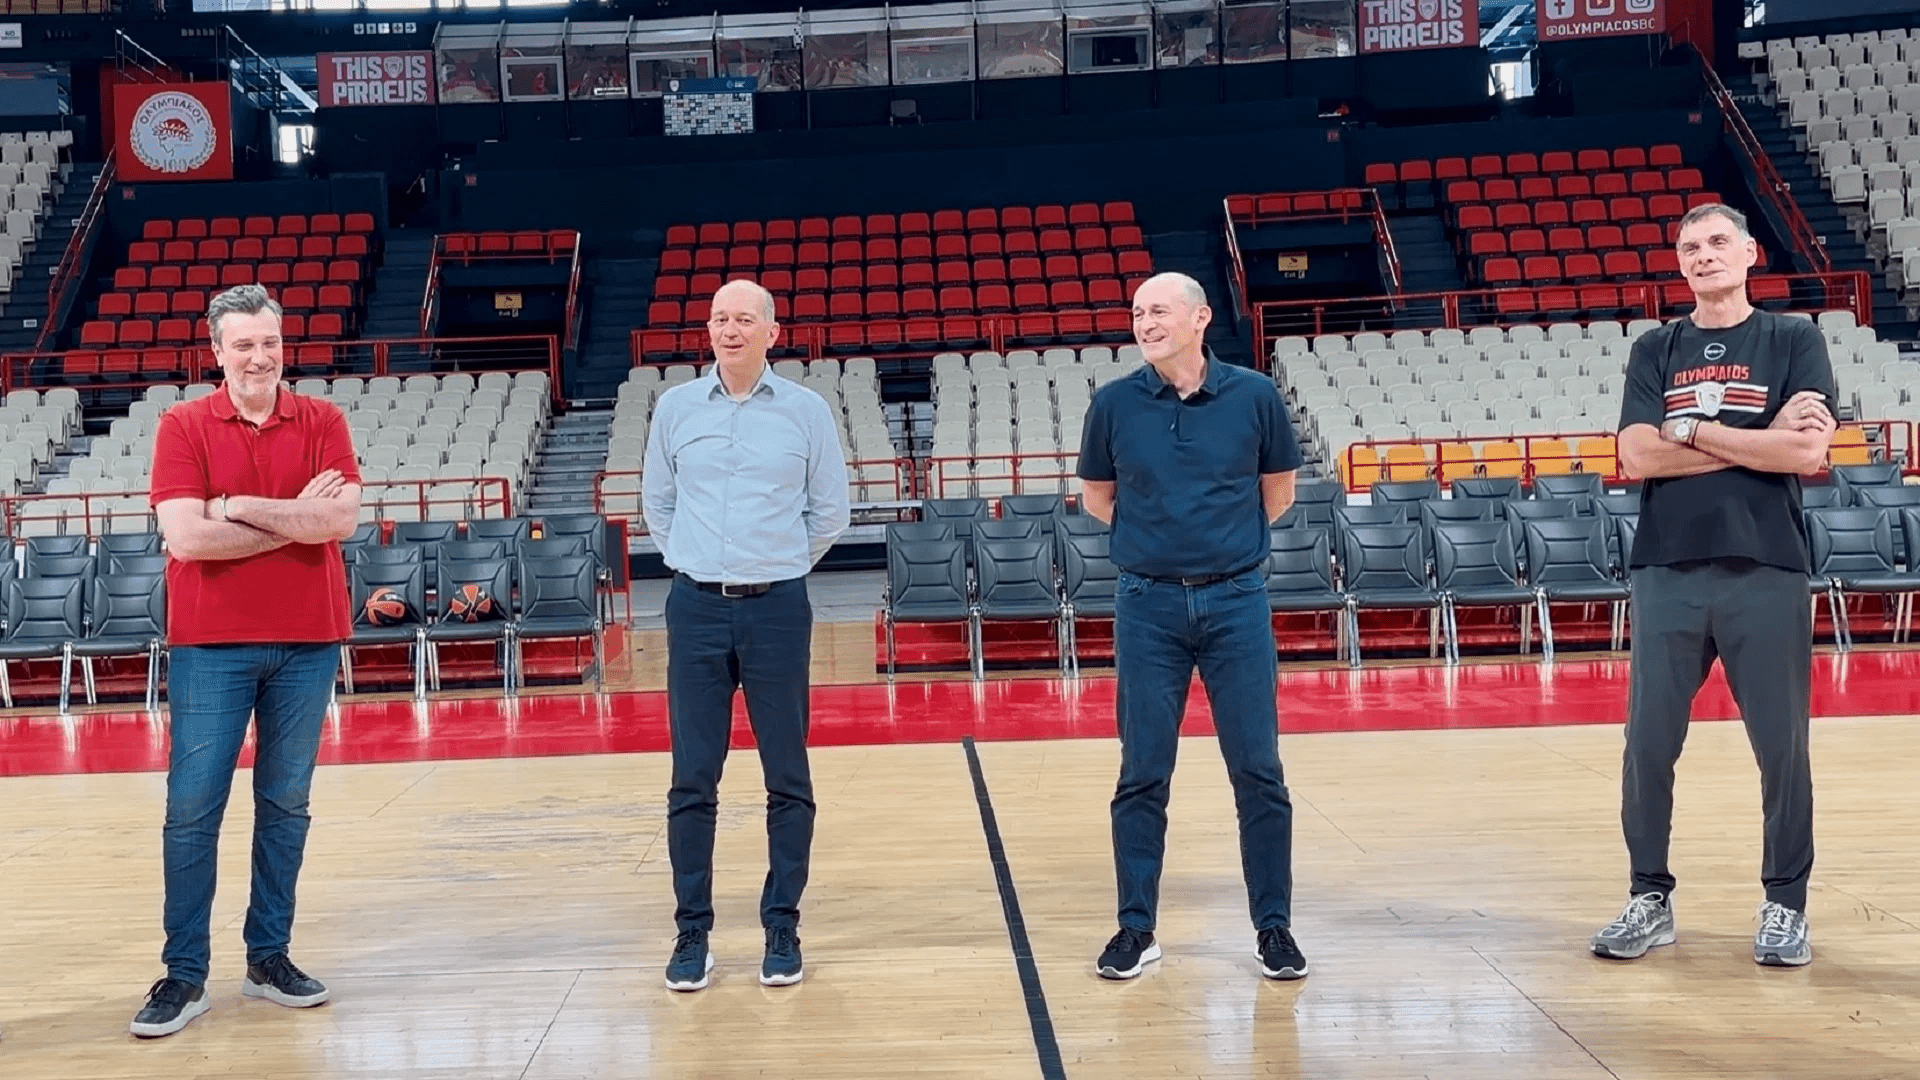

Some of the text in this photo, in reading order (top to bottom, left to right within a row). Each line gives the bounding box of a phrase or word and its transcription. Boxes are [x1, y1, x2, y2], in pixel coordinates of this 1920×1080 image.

[1363, 0, 1463, 24] THIS IS
[1546, 18, 1656, 36] @OLYMPIACOSBC
[332, 55, 426, 80] THIS IS
